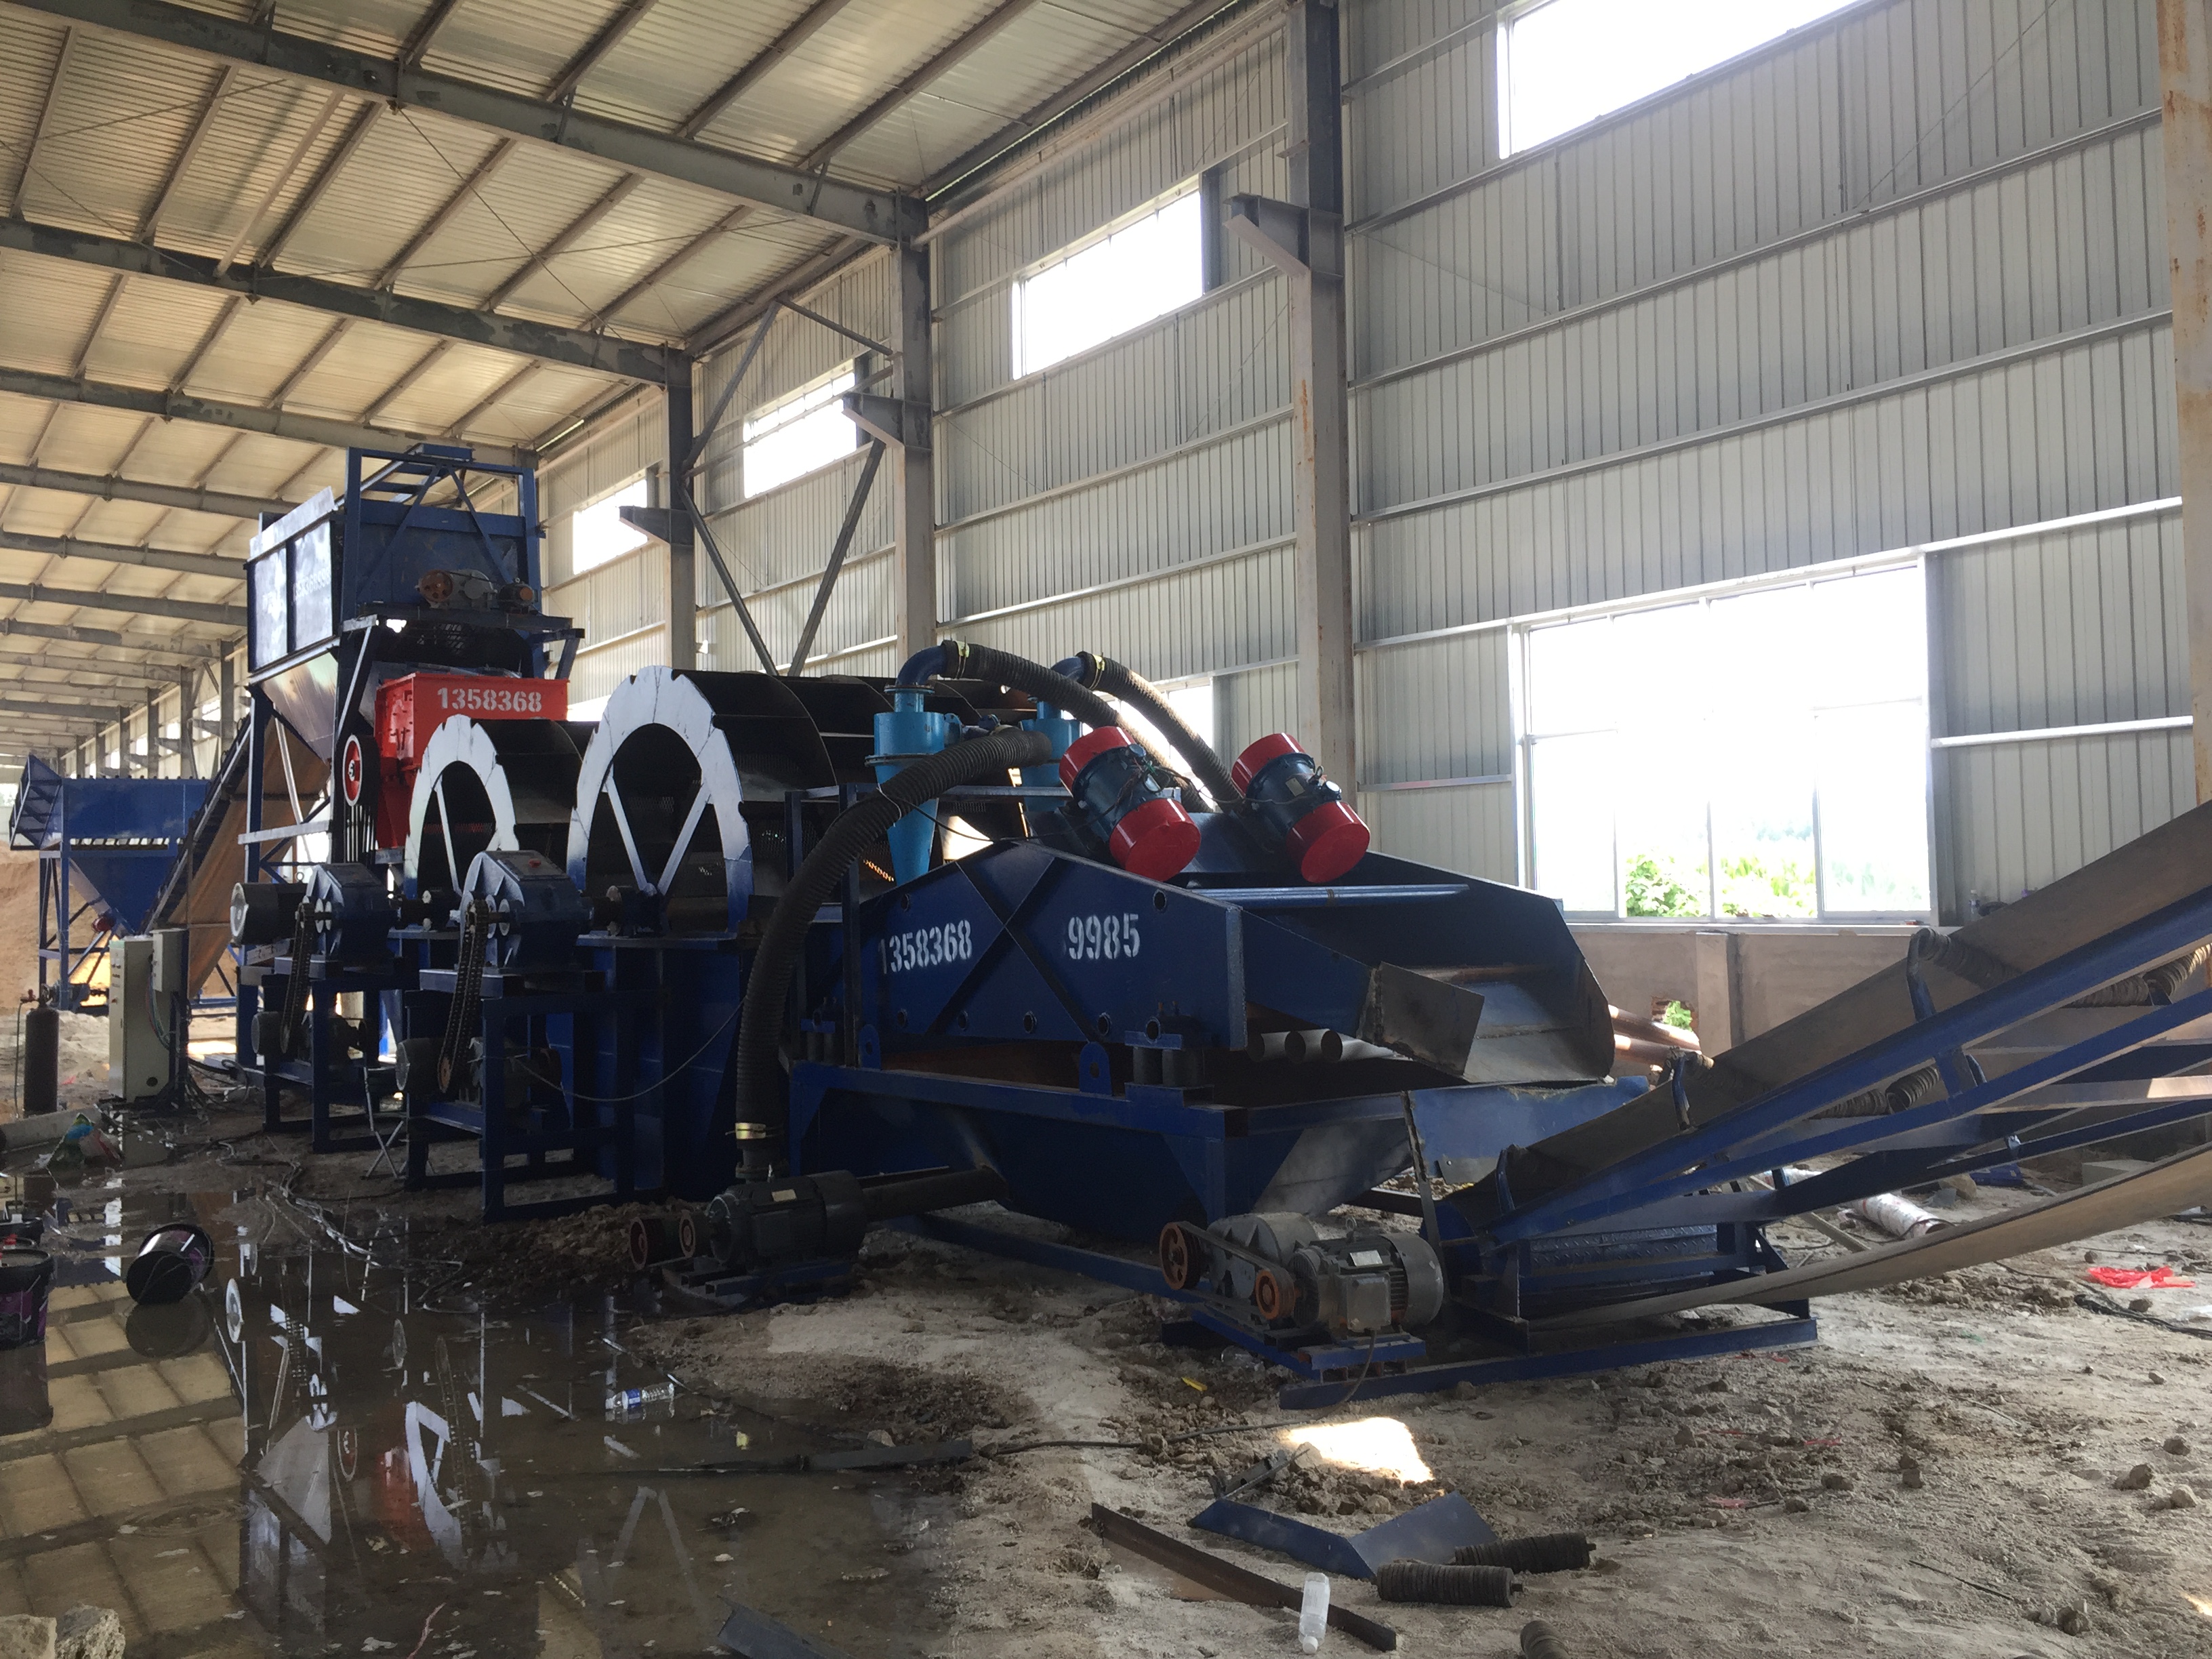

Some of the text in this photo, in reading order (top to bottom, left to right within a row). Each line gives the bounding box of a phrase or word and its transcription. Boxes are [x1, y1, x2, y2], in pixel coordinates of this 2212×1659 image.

[437, 687, 542, 712] 1358368
[878, 913, 1141, 974] 1358368 9985
